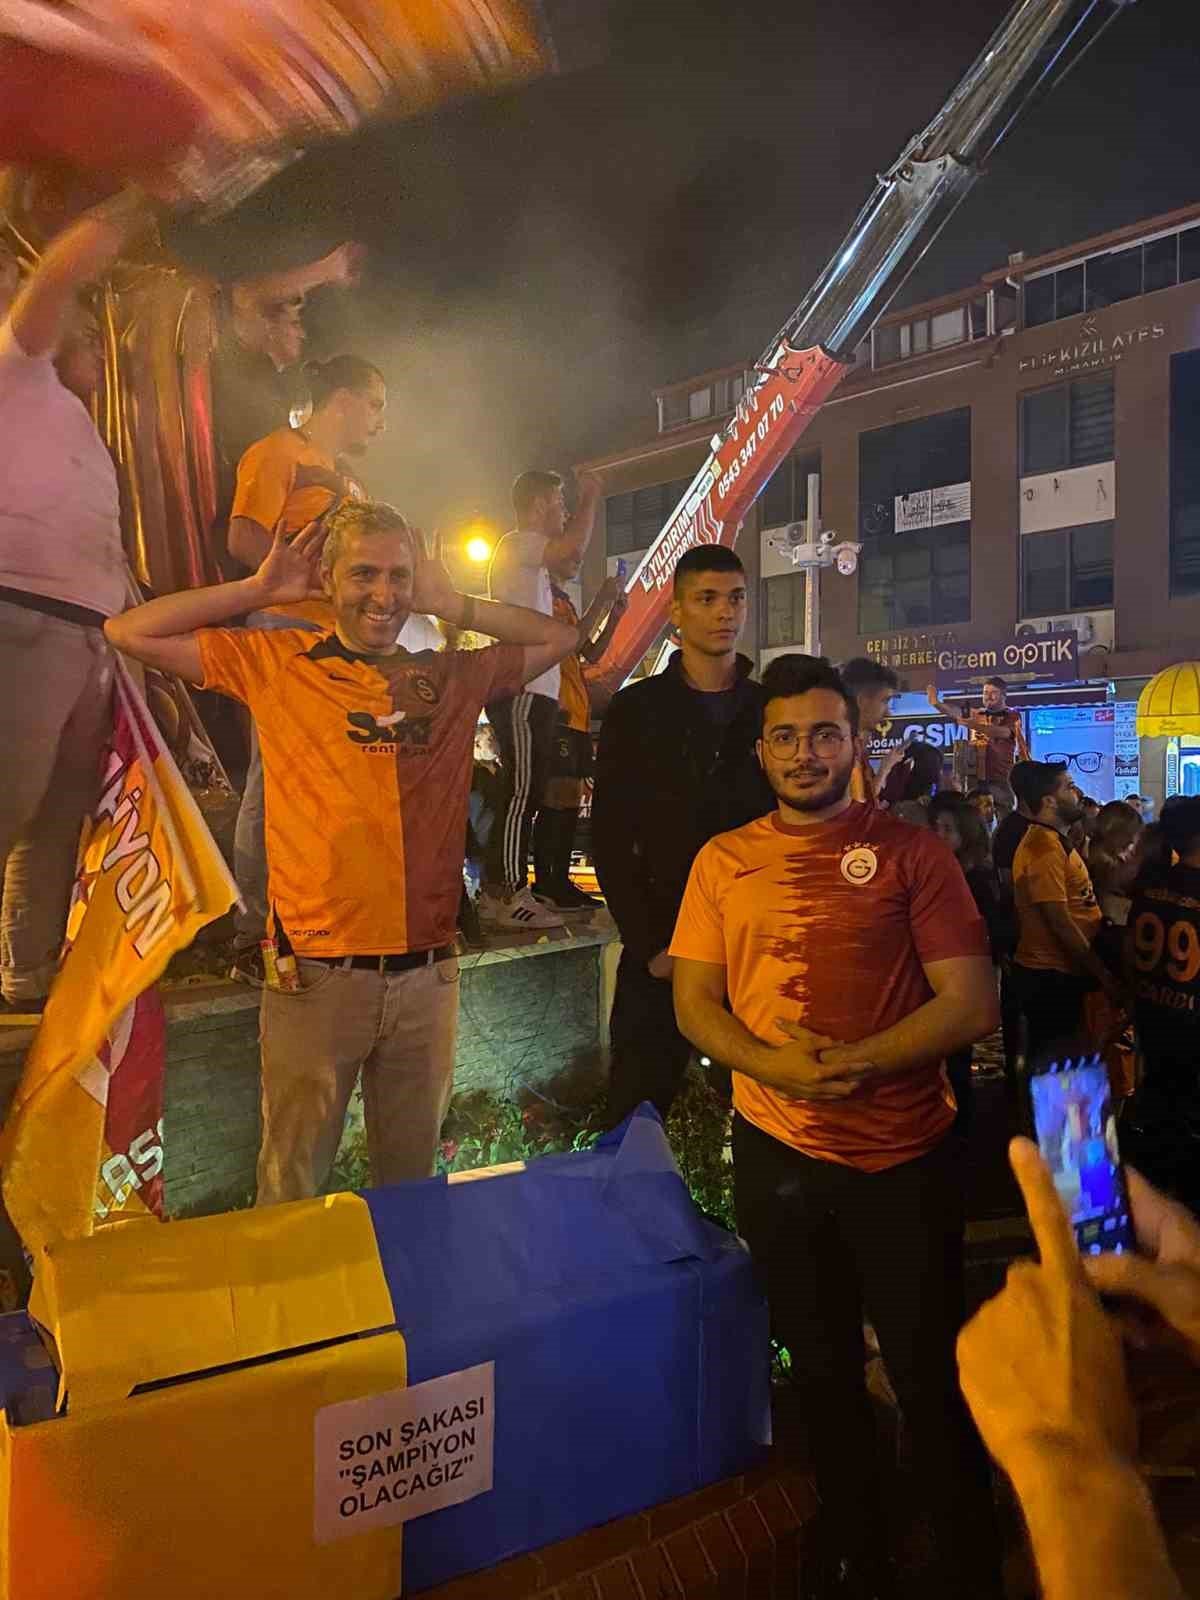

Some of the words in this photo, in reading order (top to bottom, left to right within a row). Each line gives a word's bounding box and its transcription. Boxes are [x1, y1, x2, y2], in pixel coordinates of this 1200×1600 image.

[718, 459, 740, 499] 0543
[740, 432, 756, 467] 347
[757, 412, 769, 440] 07
[770, 393, 784, 421] 70
[649, 509, 692, 577] YILDIRIM
[938, 651, 997, 670] Gizem
[903, 722, 968, 748] GSM
[1136, 911, 1200, 982] 99
[339, 1428, 392, 1461] SON
[400, 1397, 485, 1445] ŞAKASI
[339, 1427, 475, 1489] "ŞAMPİYON
[339, 1454, 475, 1518] OLACAĞIZ"
